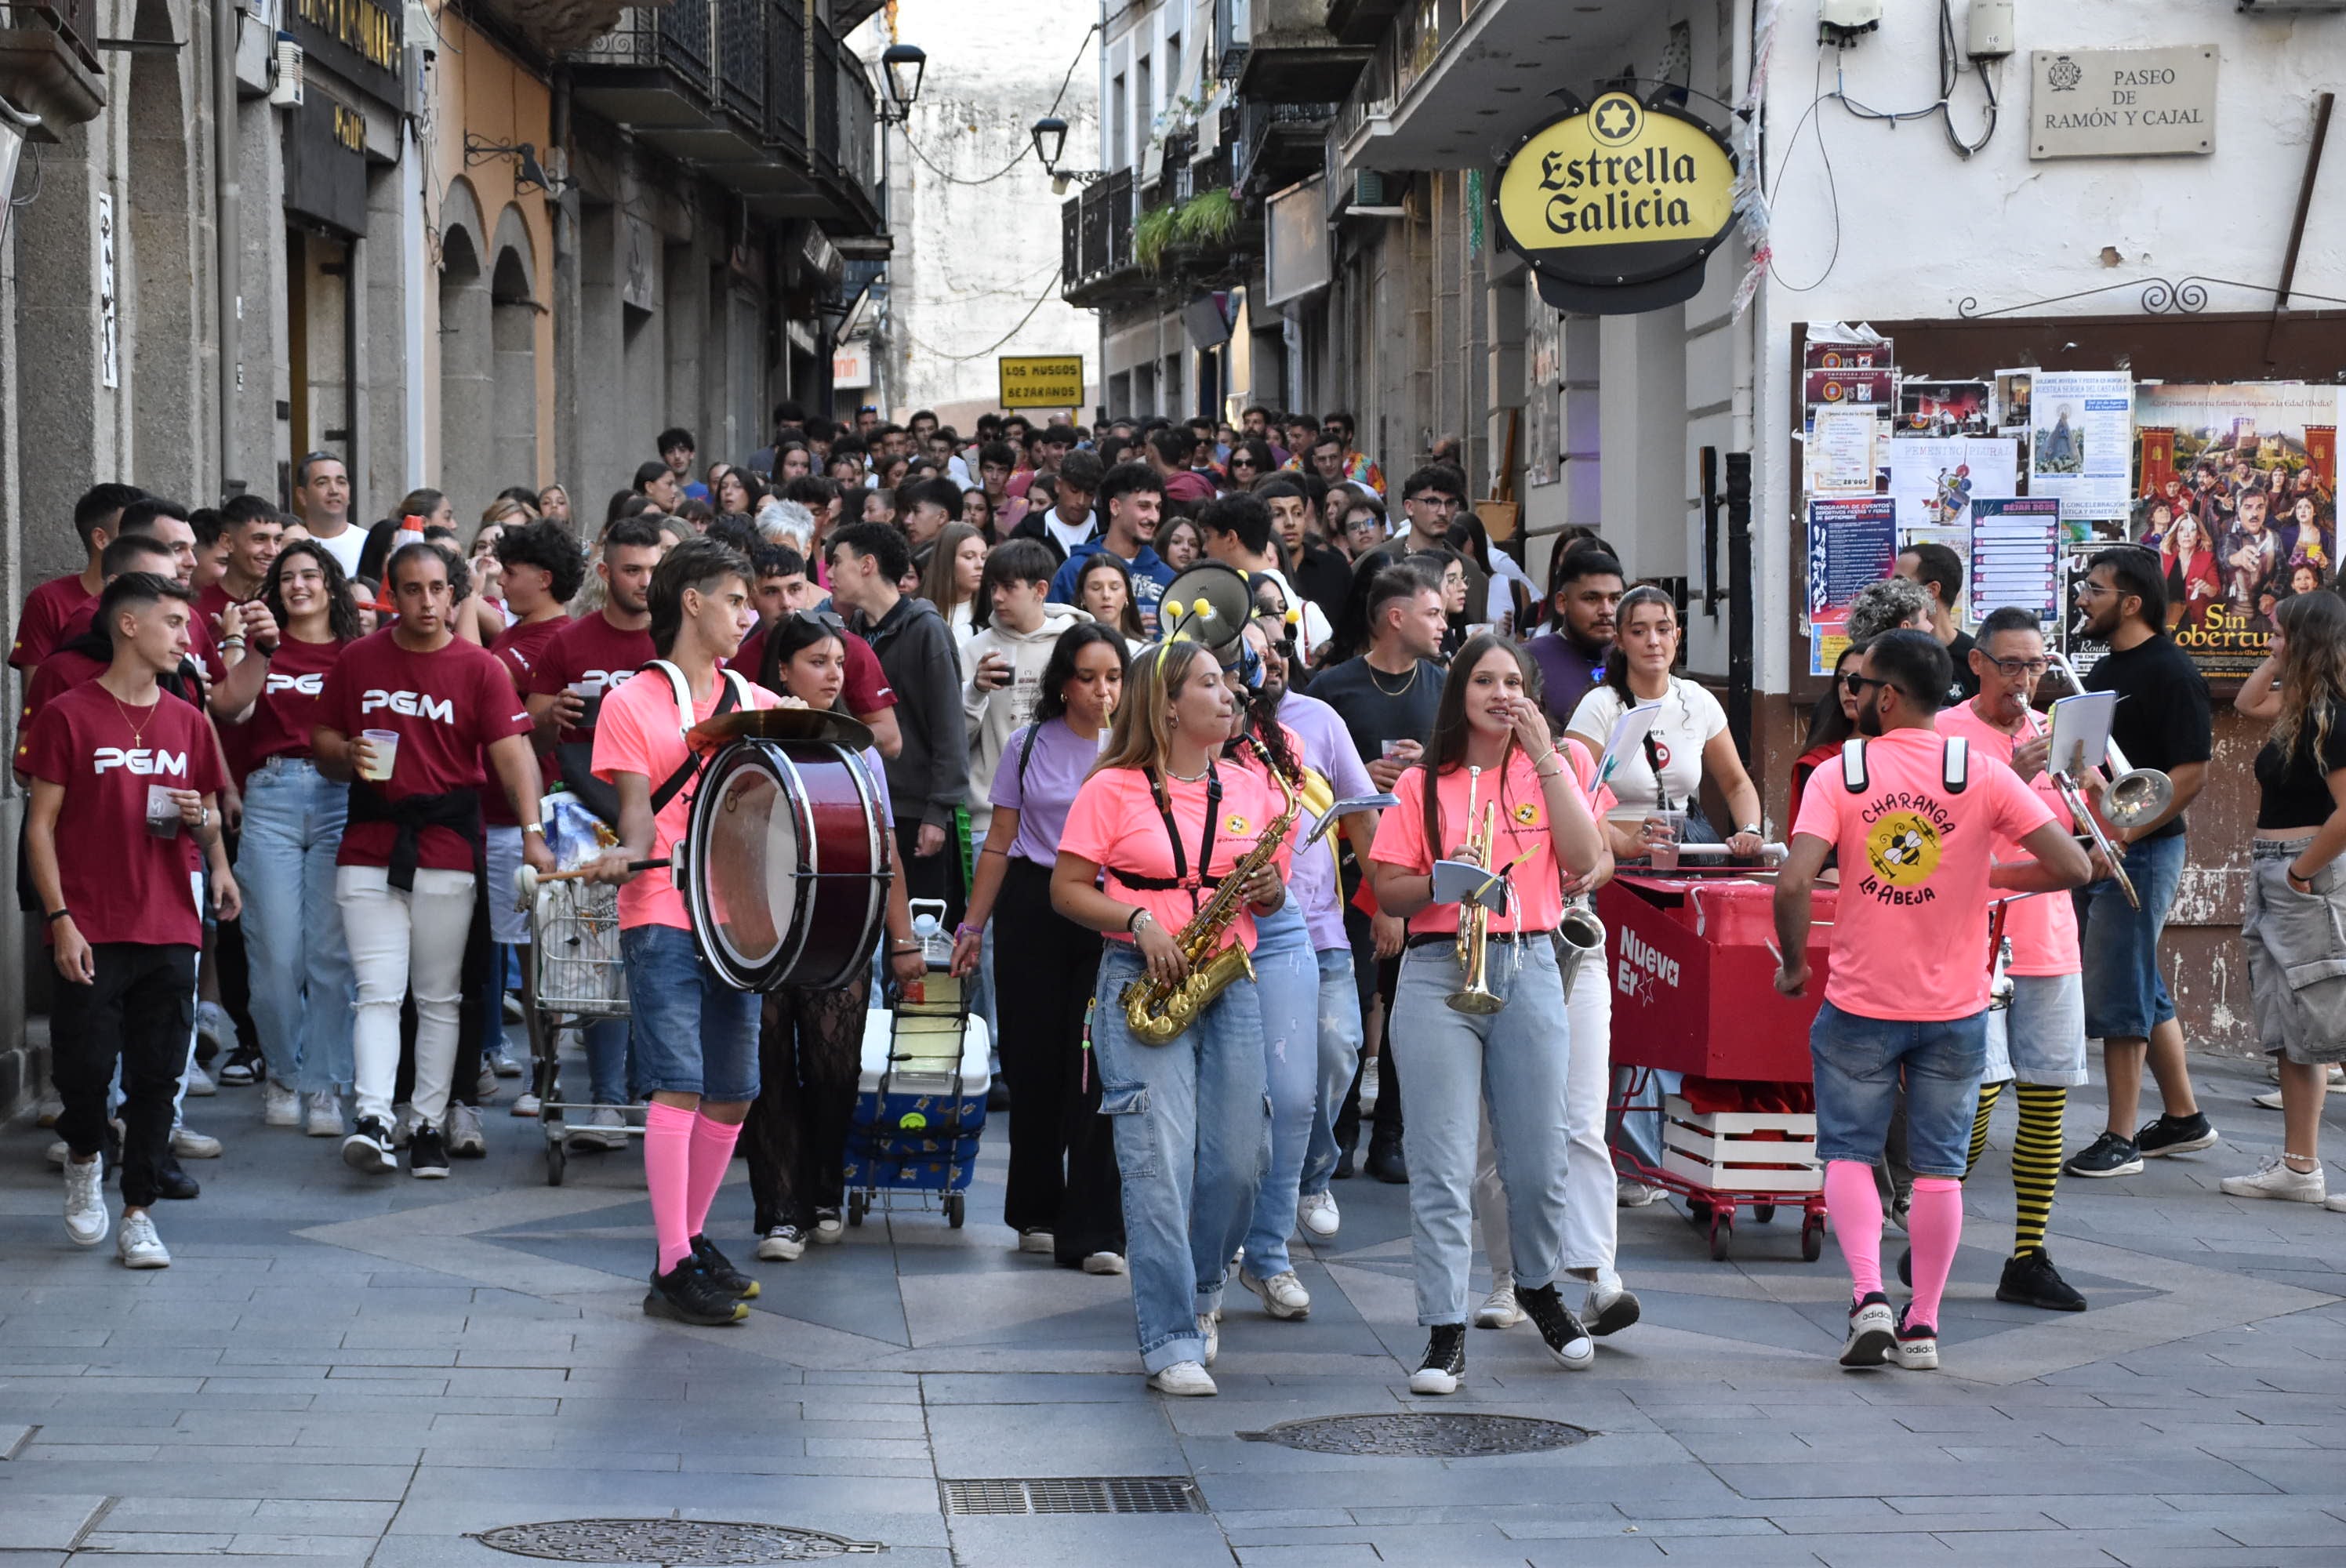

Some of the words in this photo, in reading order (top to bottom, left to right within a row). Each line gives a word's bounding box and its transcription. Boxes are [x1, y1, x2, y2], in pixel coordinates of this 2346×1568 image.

[2114, 68, 2175, 85] PASEO
[2112, 90, 2137, 105] DE
[2045, 107, 2116, 129] RAMÓN
[2124, 111, 2137, 125] Y
[2143, 108, 2203, 125] CAJAL
[1538, 147, 1698, 191] Estrella
[1545, 188, 1691, 234] Galicia
[1006, 366, 1026, 376] LOS
[1032, 365, 1077, 376] MUSGOS
[1008, 387, 1075, 397] BEJARANOS
[1905, 446, 1963, 456] FEMENINO
[1969, 446, 2012, 456] PLURAL
[2003, 503, 2030, 511] BÉJAR
[2205, 603, 2247, 630] Sin
[2080, 640, 2111, 652] Route
[2166, 622, 2273, 648] obertu
[267, 673, 323, 695] PG
[361, 689, 454, 724] PGM
[94, 746, 187, 779] PGM
[1861, 792, 1956, 836] CHARANGA
[1877, 884, 1936, 906] ABEJA
[1619, 924, 1680, 989] Nueva
